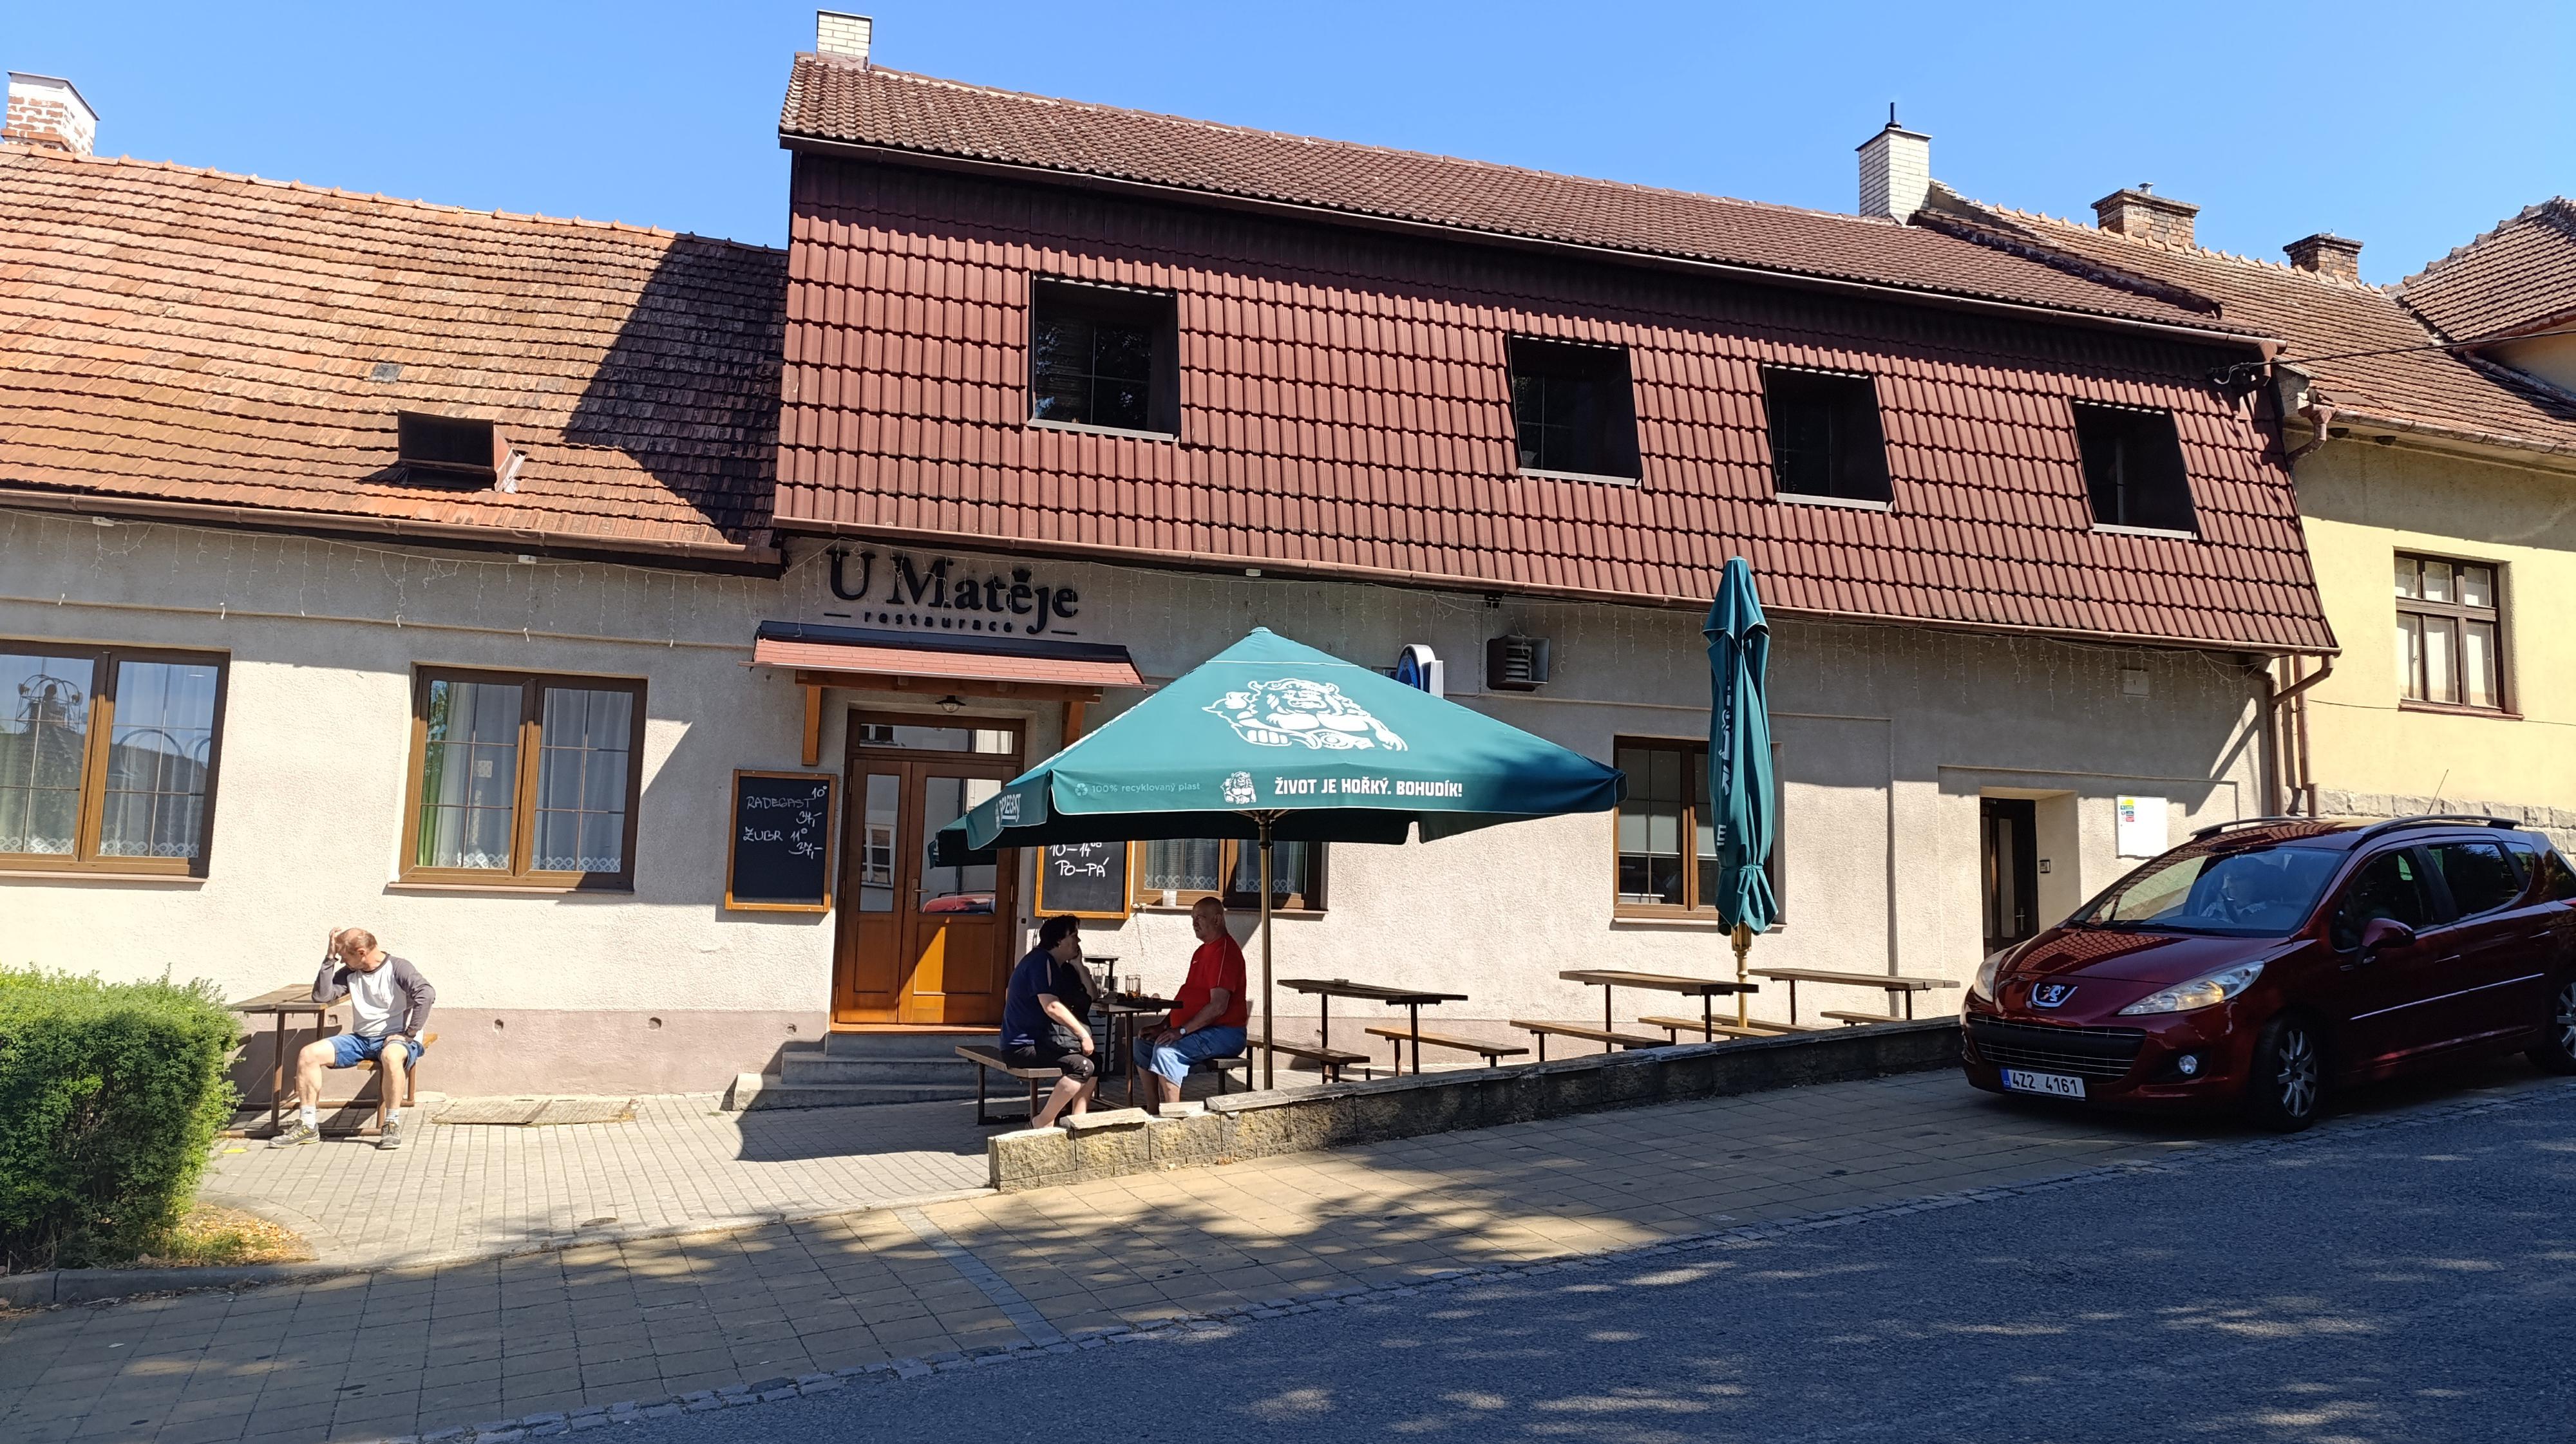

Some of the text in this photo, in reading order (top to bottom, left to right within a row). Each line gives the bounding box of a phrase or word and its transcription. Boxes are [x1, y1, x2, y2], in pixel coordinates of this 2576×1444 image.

[826, 550, 1079, 635] U Matěje
[864, 612, 1012, 633] restaurace
[1092, 785, 1118, 793] 100%
[1122, 783, 1175, 792] recyklovaný
[1274, 776, 1463, 798] ŽIVOT JE HOŘKÝ. BOHUDÍK!
[746, 796, 815, 810] RADEGAST
[2012, 1073, 2078, 1094] 4Z2 4161
